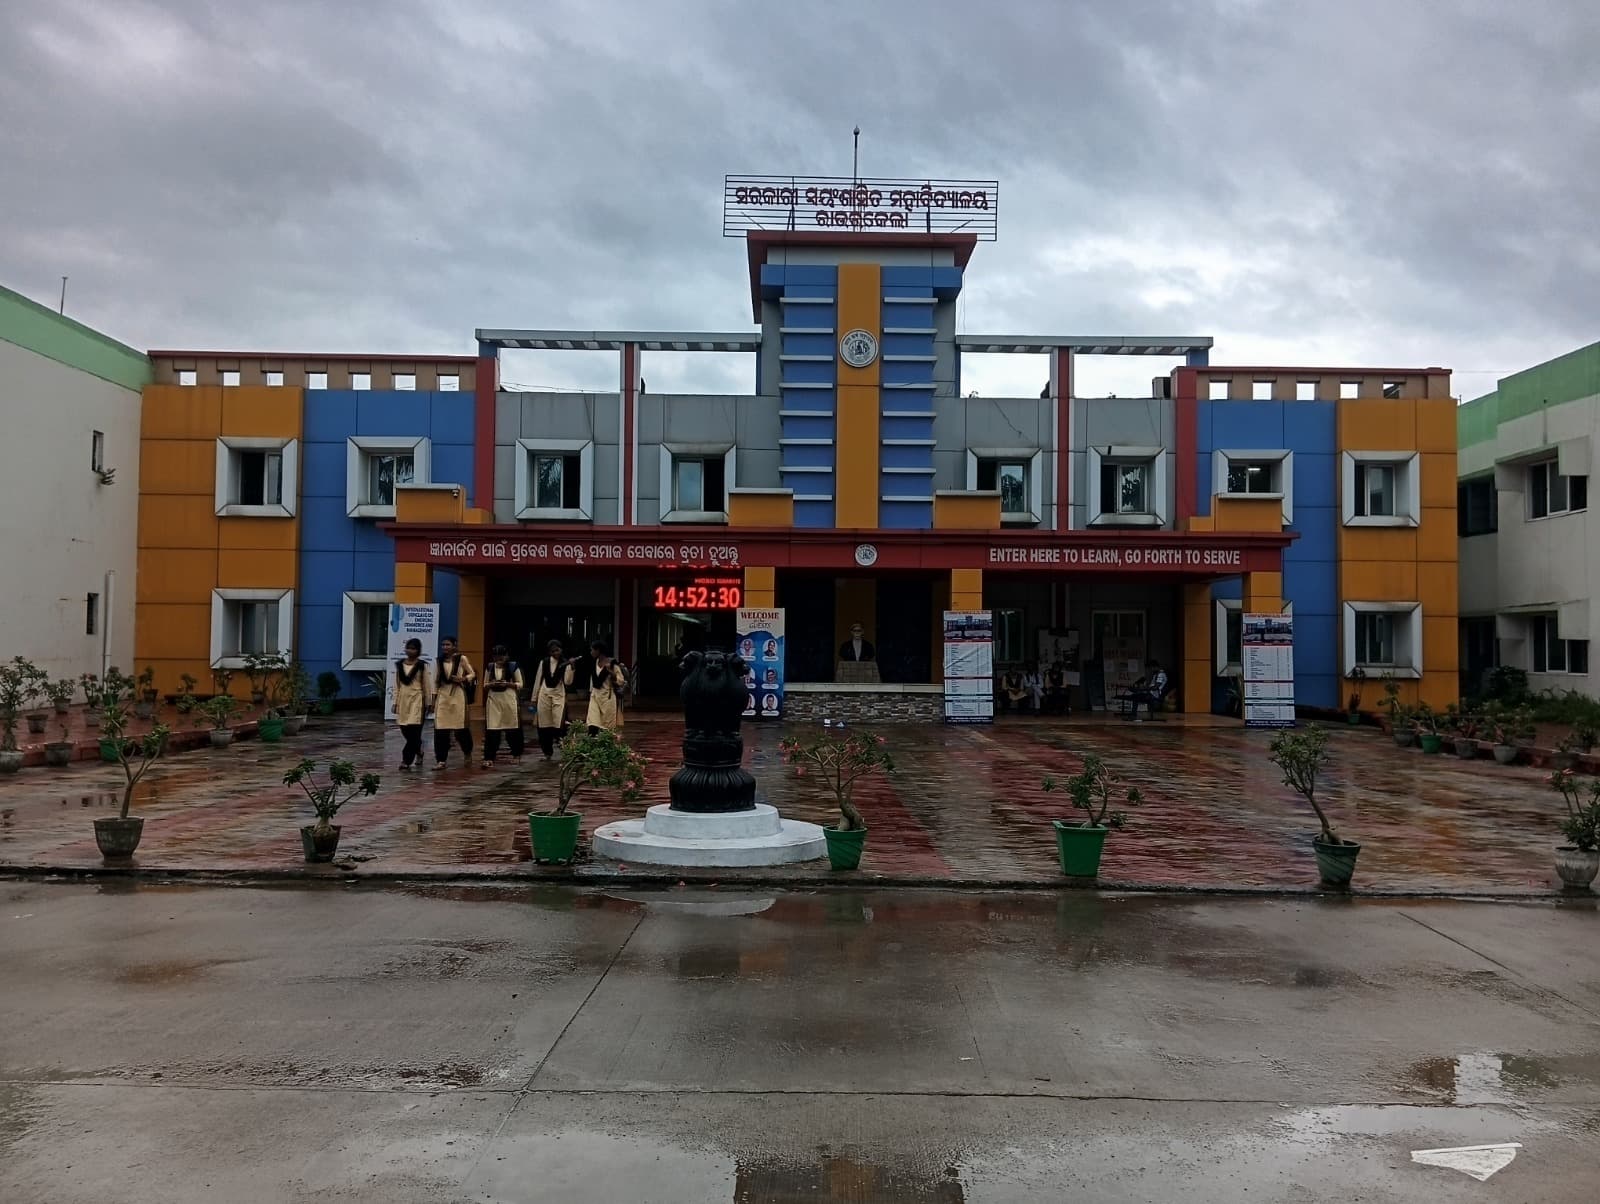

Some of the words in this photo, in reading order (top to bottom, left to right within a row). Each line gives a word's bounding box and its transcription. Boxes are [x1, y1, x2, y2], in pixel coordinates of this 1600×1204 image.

[481, 539, 507, 558] ପାଇଁ
[510, 543, 548, 561] ପ୍ରବେଶ
[589, 544, 622, 558] ସମାଜ
[627, 544, 675, 560] ସେବାରେ
[680, 545, 704, 564] ବ୍ରତୀ
[990, 548, 1027, 562] ENTER
[1030, 548, 1060, 563] HERE
[1063, 549, 1078, 563] TO
[1081, 549, 1121, 567] LEARN,
[1125, 549, 1141, 564] GO
[1144, 549, 1182, 564] FORTH
[1185, 550, 1200, 564] TO
[1203, 550, 1240, 565] SERVE
[655, 586, 740, 608] 14:52:30
[741, 611, 779, 619] WELCOME
